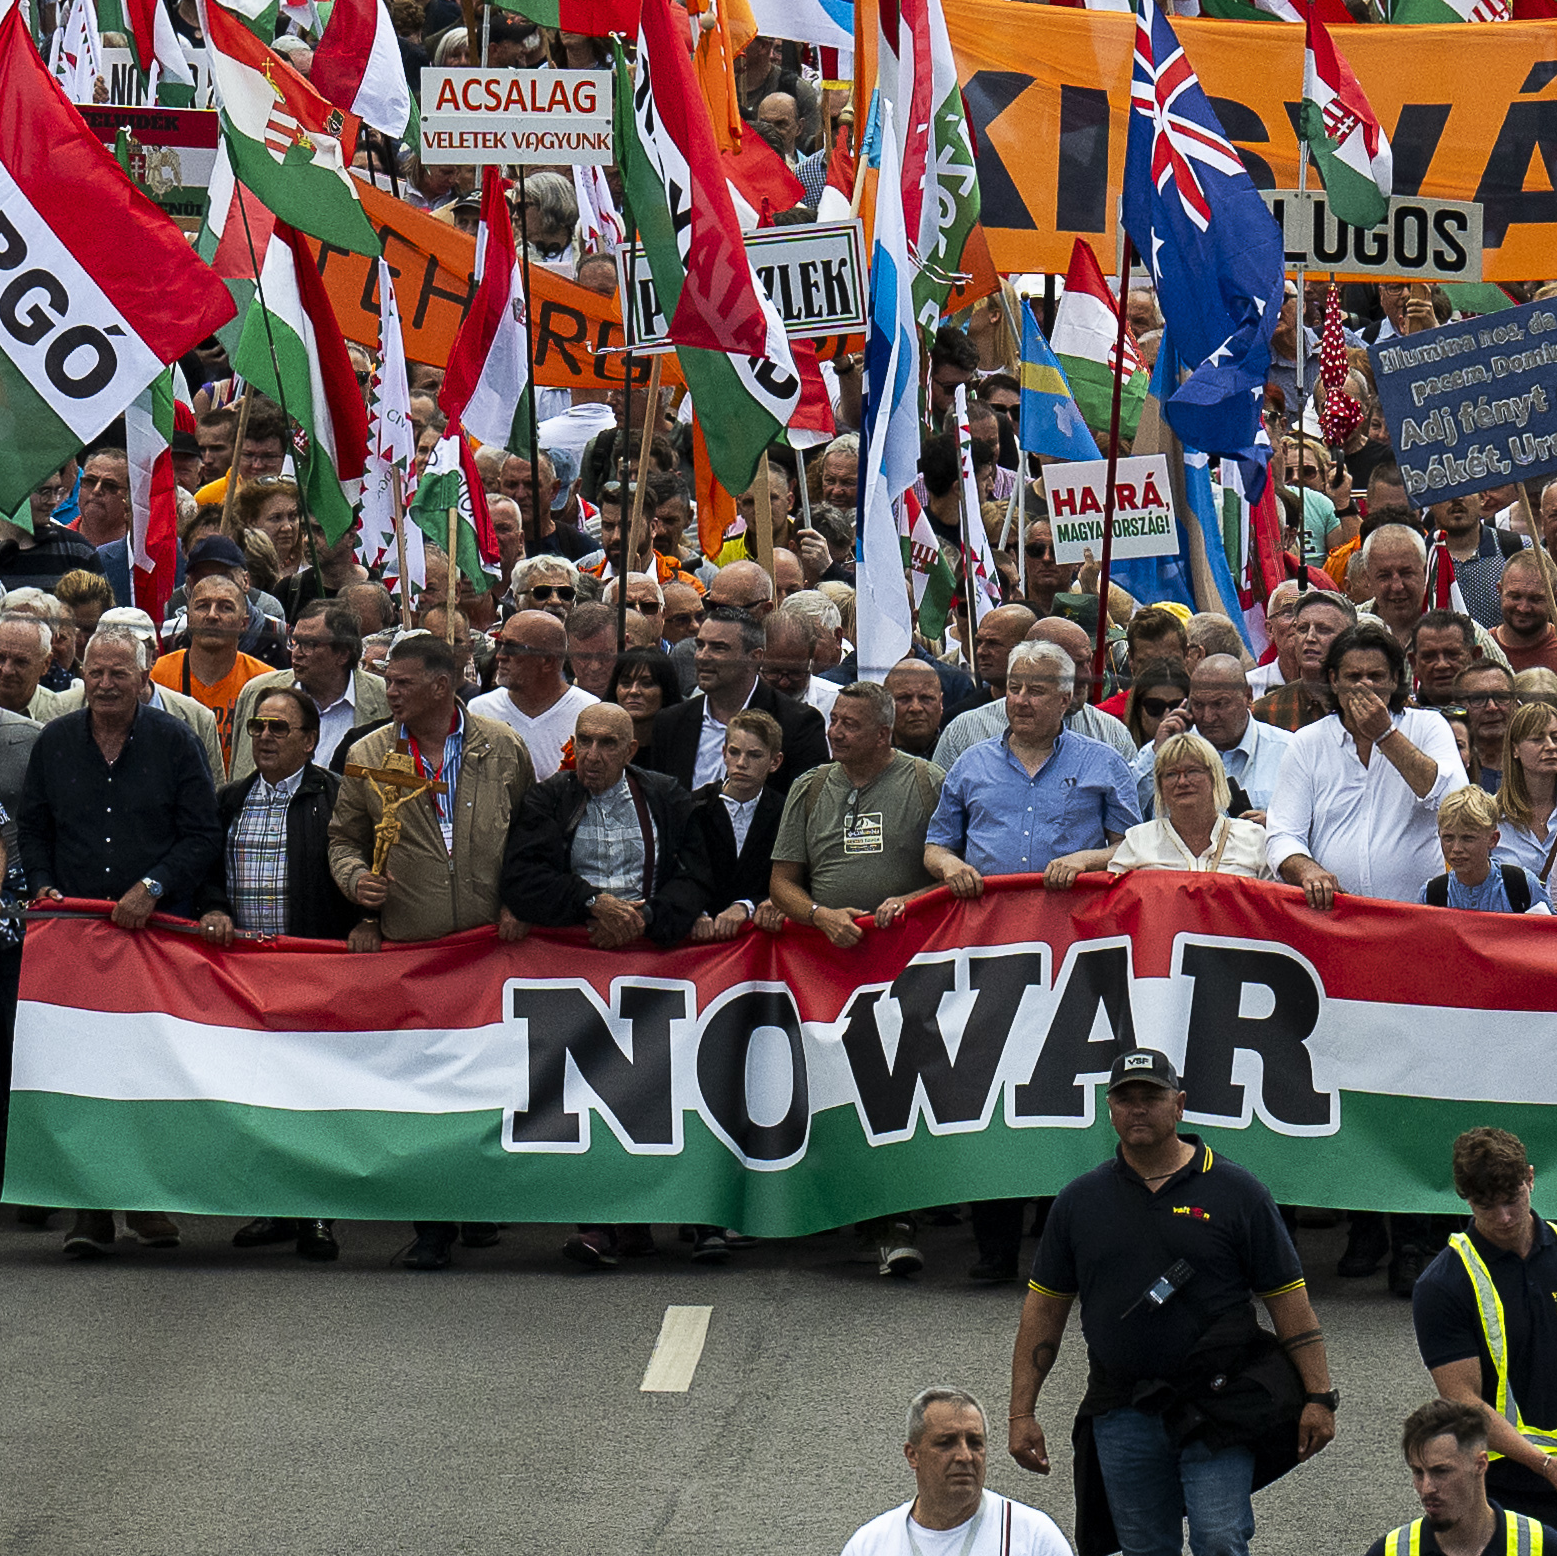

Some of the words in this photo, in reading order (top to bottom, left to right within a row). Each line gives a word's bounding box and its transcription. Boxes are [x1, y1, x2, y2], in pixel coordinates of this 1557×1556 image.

[436, 78, 597, 114] ACSALAG
[422, 131, 508, 149] VELETEK
[511, 132, 611, 153] VAGYUNK
[1379, 333, 1477, 375] Illumina
[1478, 322, 1526, 349] nos,
[1411, 364, 1493, 407] pacem,
[1400, 406, 1458, 451] Adj
[1457, 384, 1549, 434] fényt
[1051, 472, 1170, 517] HARÁ,
[1400, 444, 1512, 497] békét,
[506, 980, 809, 1169] NO
[840, 943, 1338, 1146] WAR
